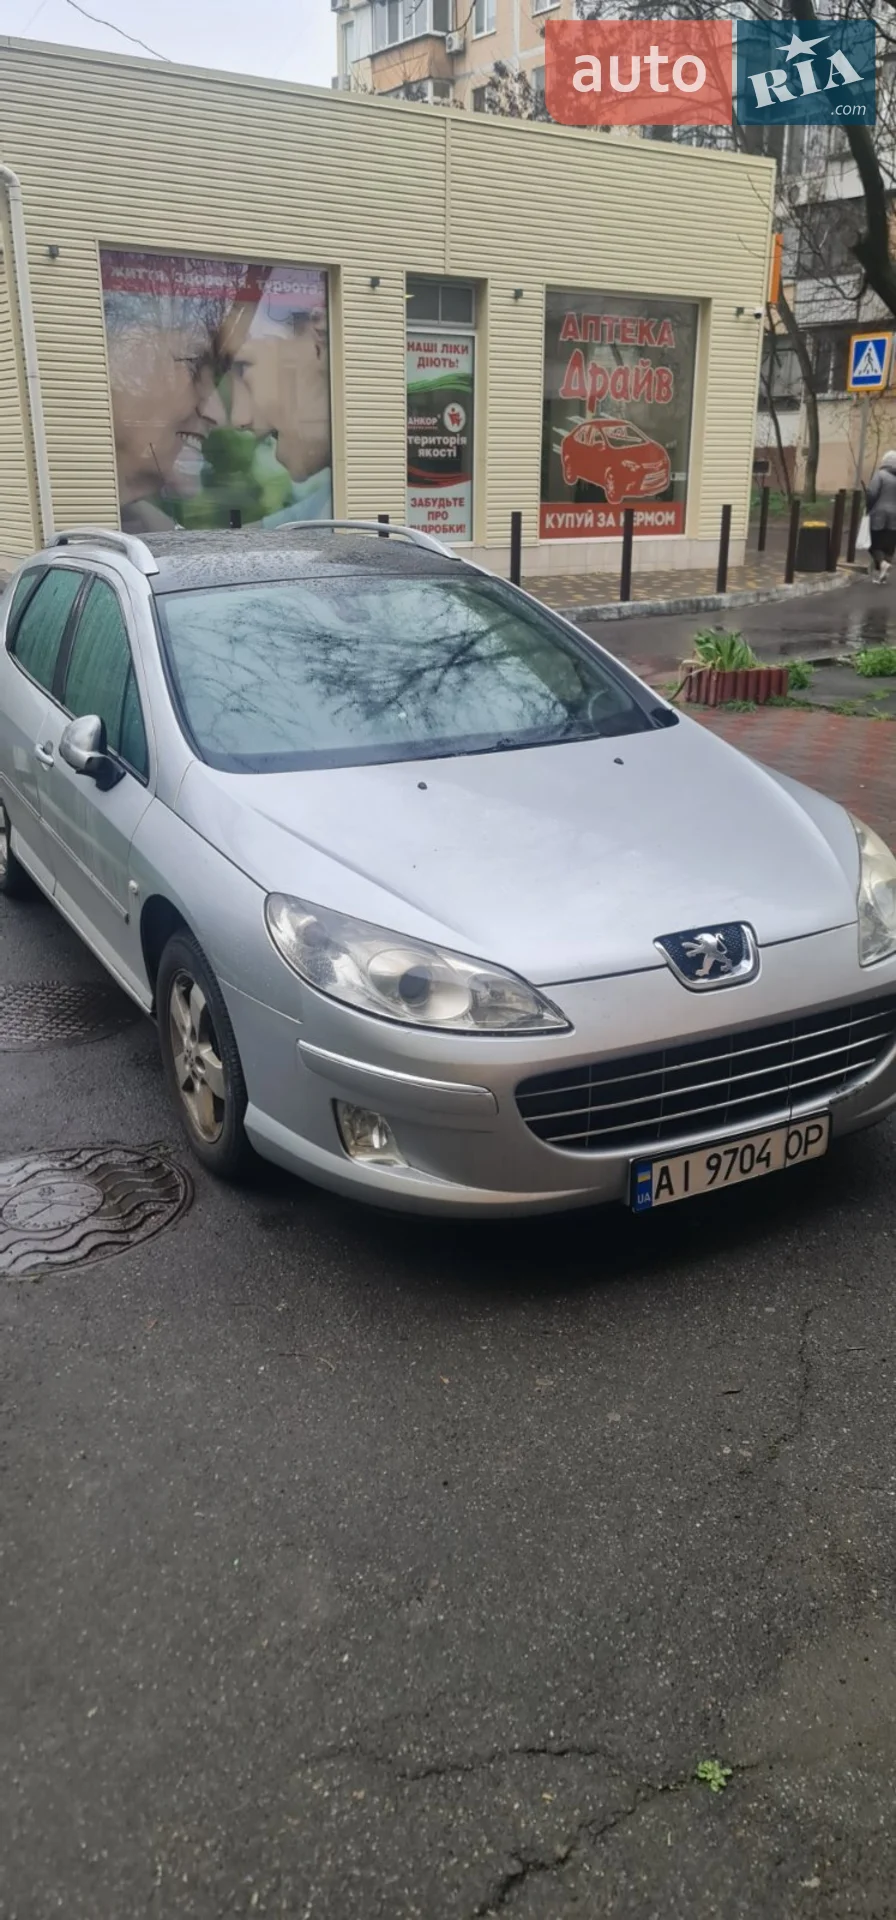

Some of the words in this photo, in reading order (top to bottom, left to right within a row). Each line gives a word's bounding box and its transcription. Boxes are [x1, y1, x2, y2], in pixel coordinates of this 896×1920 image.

[559, 312, 675, 348] АПТЕКА
[441, 343, 469, 355] ЛІКИ
[559, 348, 674, 414] Драйв
[418, 446, 457, 458] якості
[411, 497, 465, 509] ЗАБУДЬТЕ
[427, 510, 449, 521] ПРО
[545, 509, 594, 529] КУПУЙ
[597, 511, 616, 528] ЗА
[706, 1138, 771, 1186] 9704
[638, 1192, 651, 1204] UA
